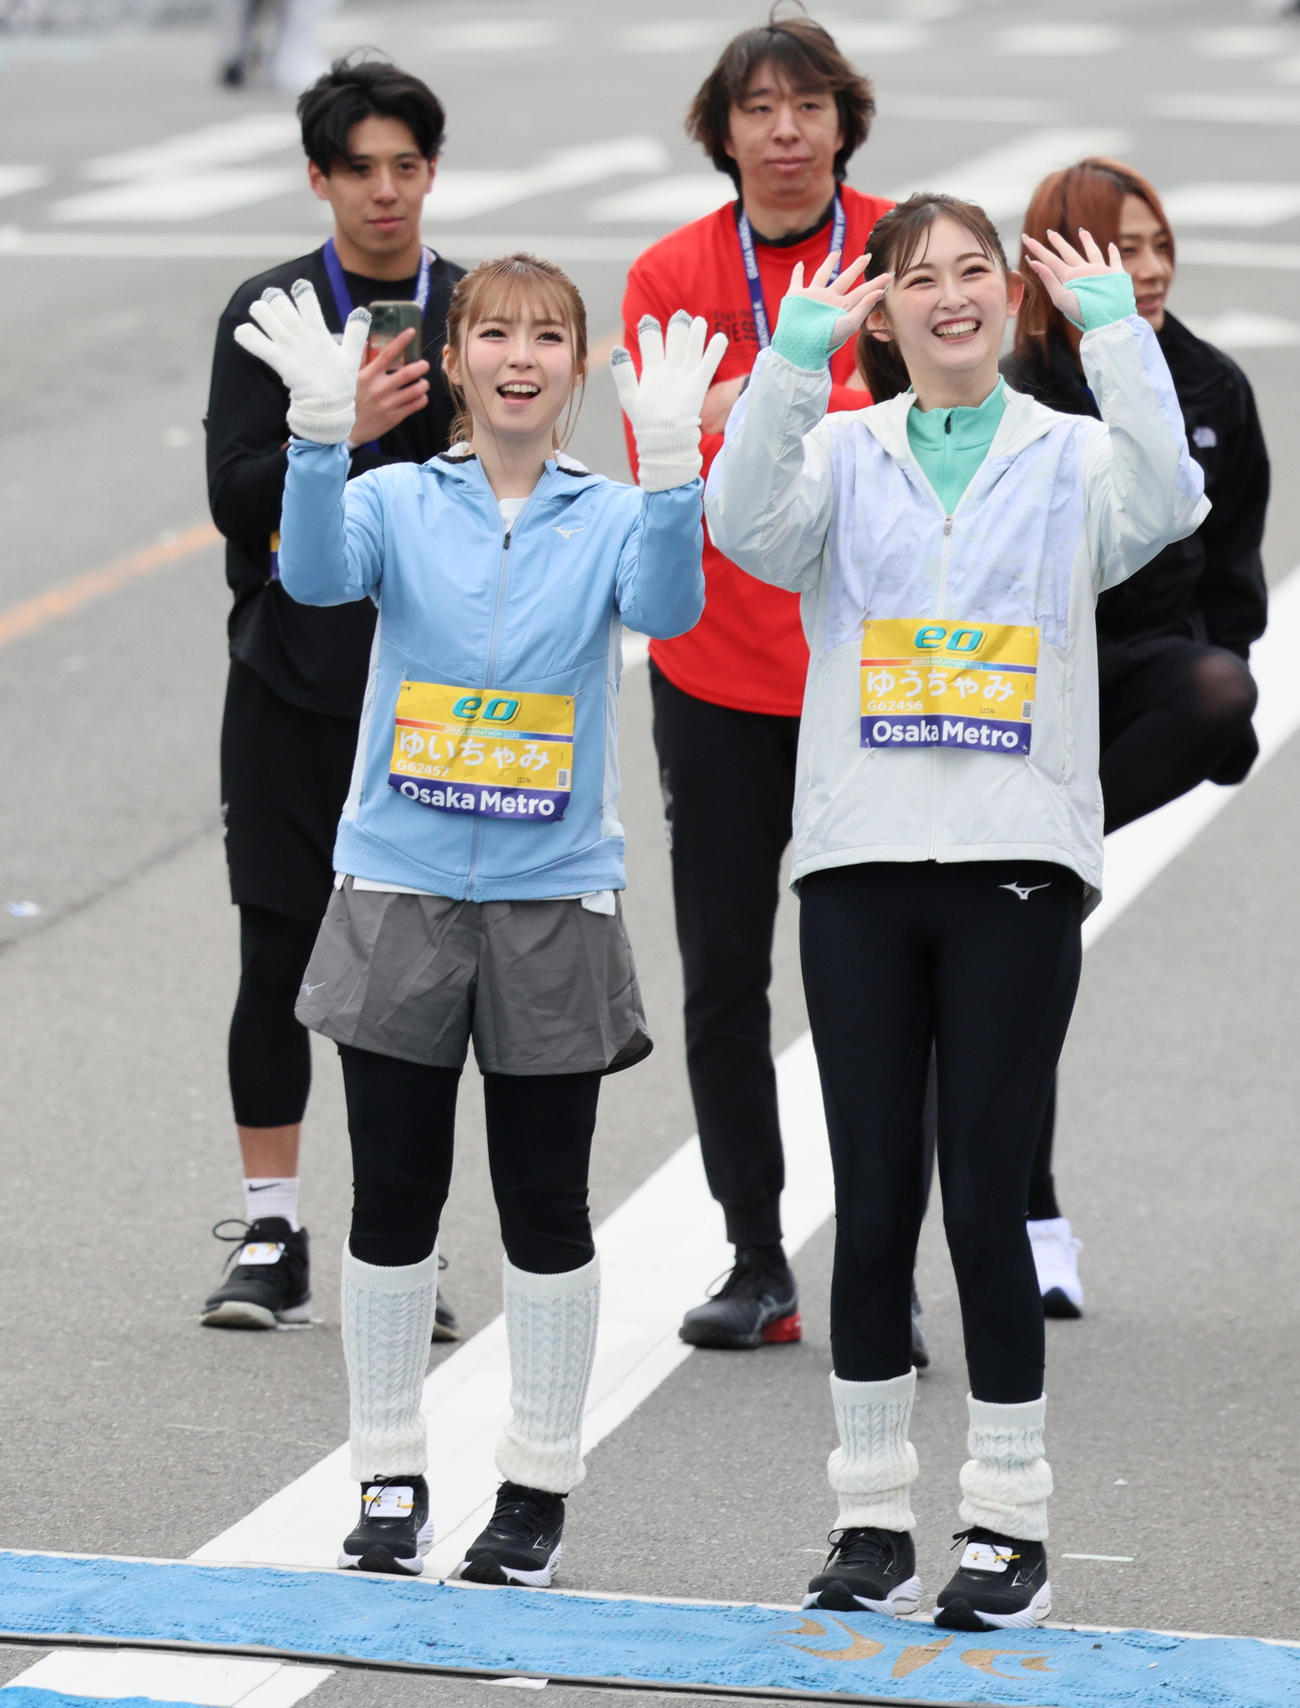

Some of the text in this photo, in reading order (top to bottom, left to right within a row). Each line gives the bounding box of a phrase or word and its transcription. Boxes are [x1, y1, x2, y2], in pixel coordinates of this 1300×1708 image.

[914, 625, 984, 651] eo
[866, 669, 1015, 701] ゆうちゃみ
[452, 695, 519, 721] eo
[866, 700, 924, 712] G62456
[872, 720, 1019, 748] Osaka Metro
[400, 731, 550, 771] ゆいちゃみ
[395, 759, 450, 777] G62457
[400, 781, 555, 816] Osaka Metro
